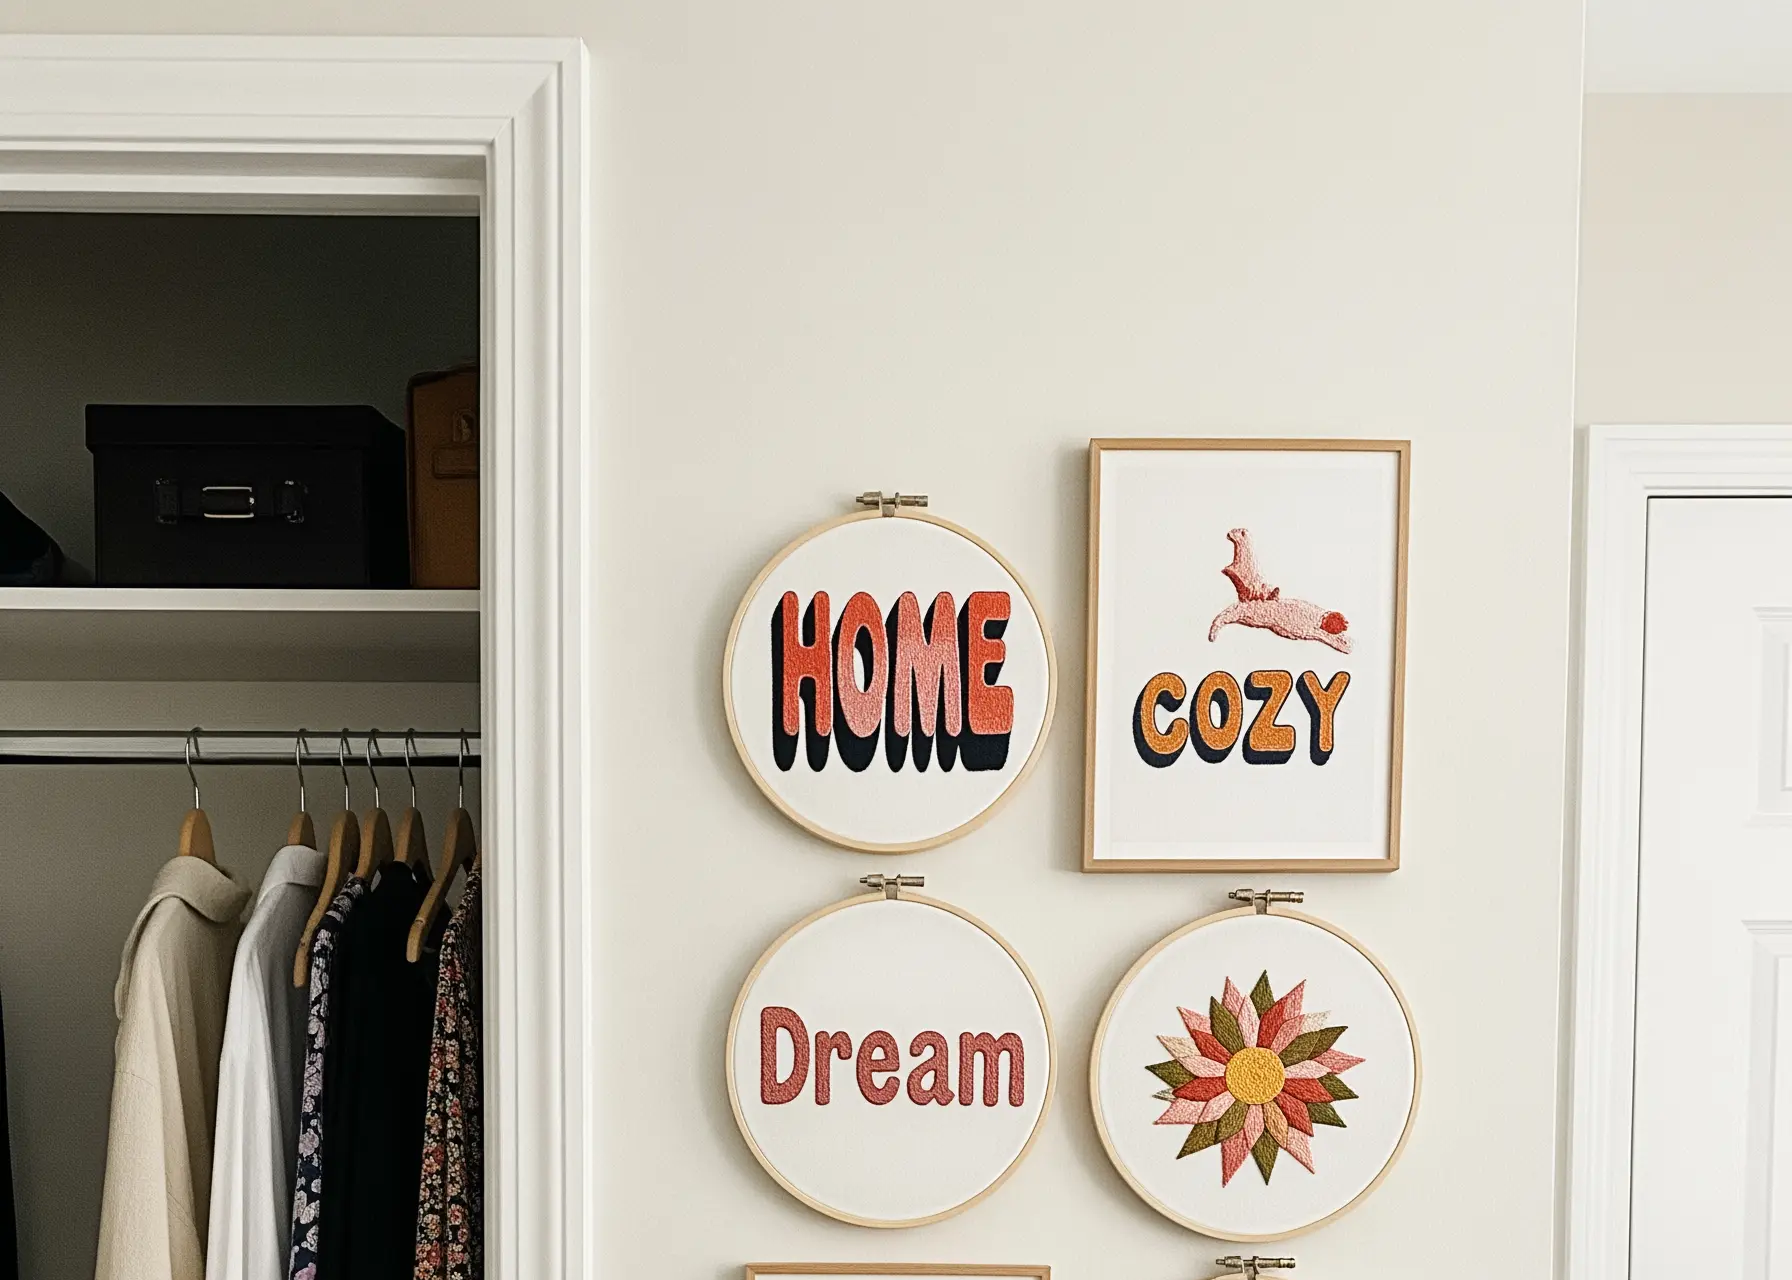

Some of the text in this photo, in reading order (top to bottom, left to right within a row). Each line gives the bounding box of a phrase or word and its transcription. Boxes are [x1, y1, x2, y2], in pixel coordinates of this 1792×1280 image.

[772, 590, 1015, 772] HOME
[1133, 670, 1350, 768] COZY
[760, 1006, 1025, 1107] Dream
